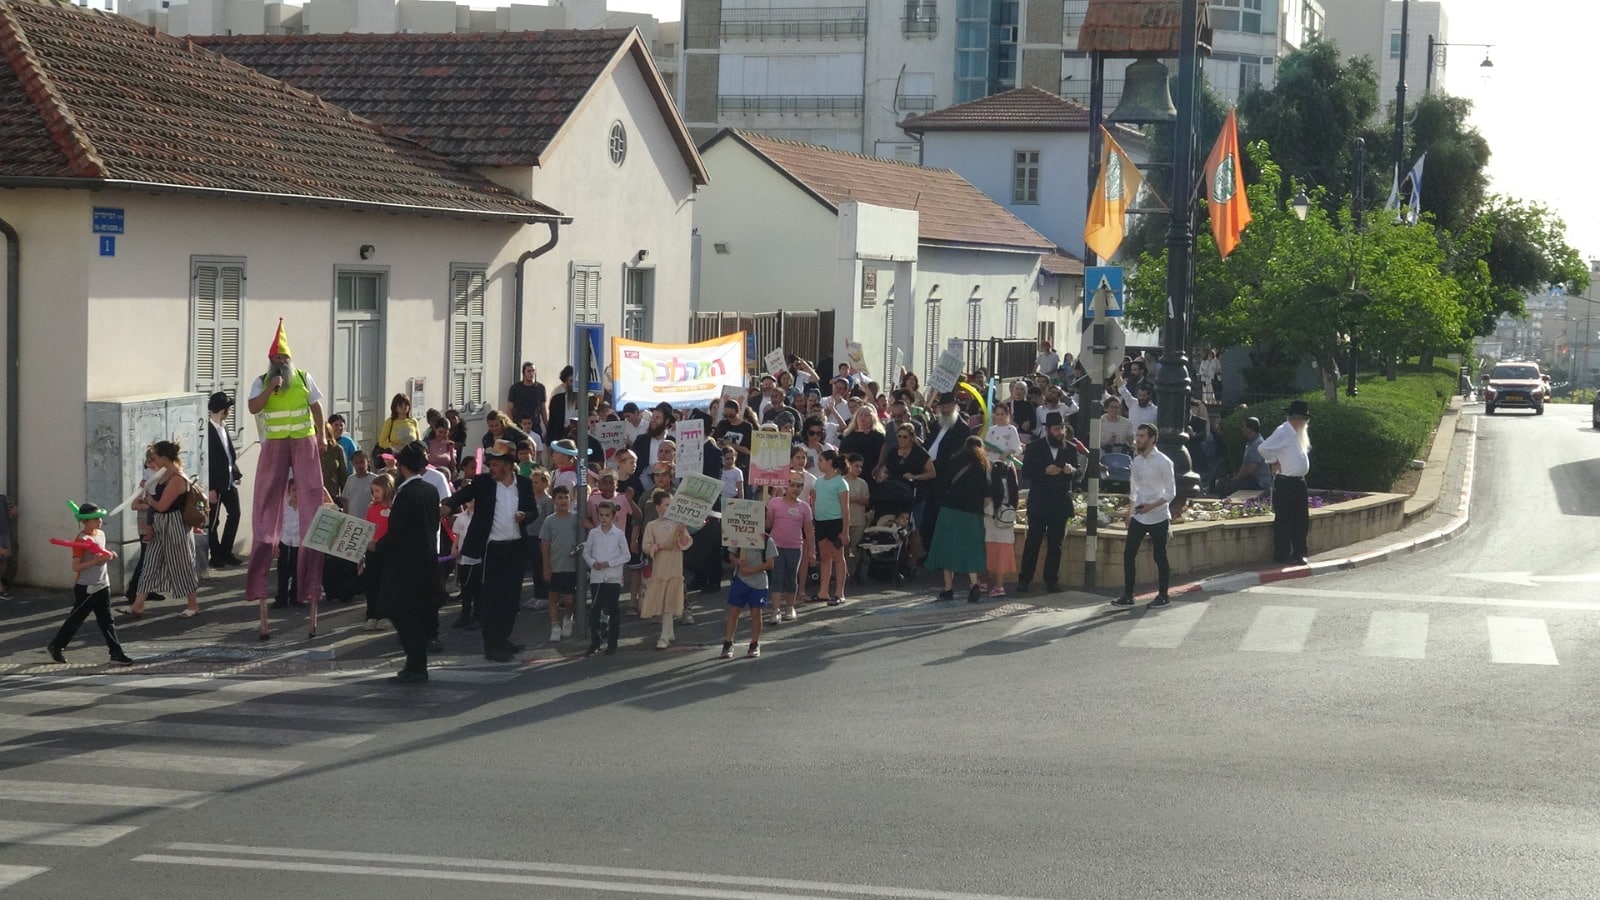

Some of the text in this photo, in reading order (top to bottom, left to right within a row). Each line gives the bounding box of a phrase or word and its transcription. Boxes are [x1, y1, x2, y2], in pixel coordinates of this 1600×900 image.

[642, 356, 726, 383] התהלוכה
[677, 504, 701, 518] בחינוך
[731, 524, 755, 534] כשר
[742, 518, 758, 526] אוכל
[345, 527, 364, 552] בחינוך
